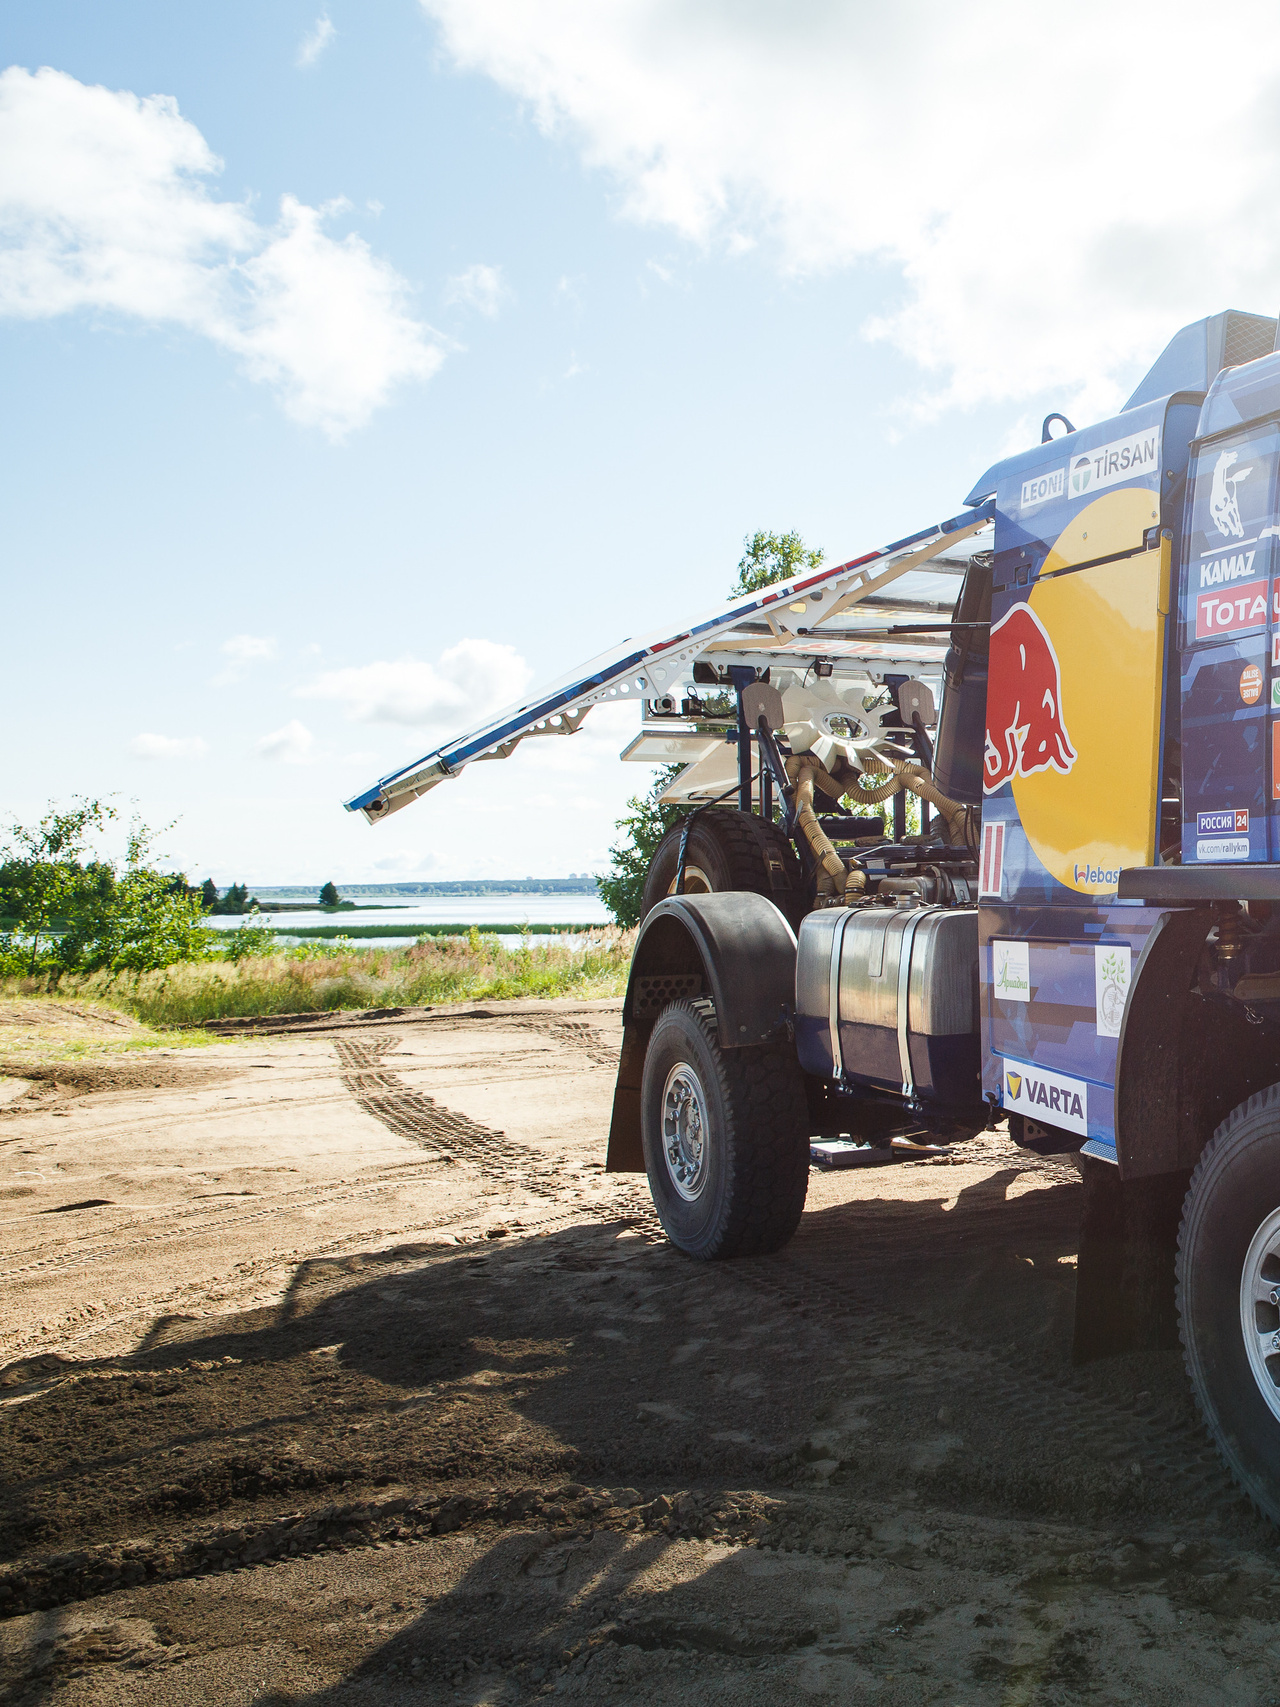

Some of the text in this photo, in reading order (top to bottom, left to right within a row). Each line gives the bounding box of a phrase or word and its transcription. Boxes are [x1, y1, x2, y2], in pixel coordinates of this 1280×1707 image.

[1022, 473, 1063, 505] LEONI
[1200, 551, 1256, 588] KAMAZ
[1201, 815, 1247, 830] РОССИЯ 24
[1198, 840, 1248, 855] vk.com/rallykm
[1074, 864, 1123, 886] Webas
[1025, 1078, 1085, 1119] VARTA
